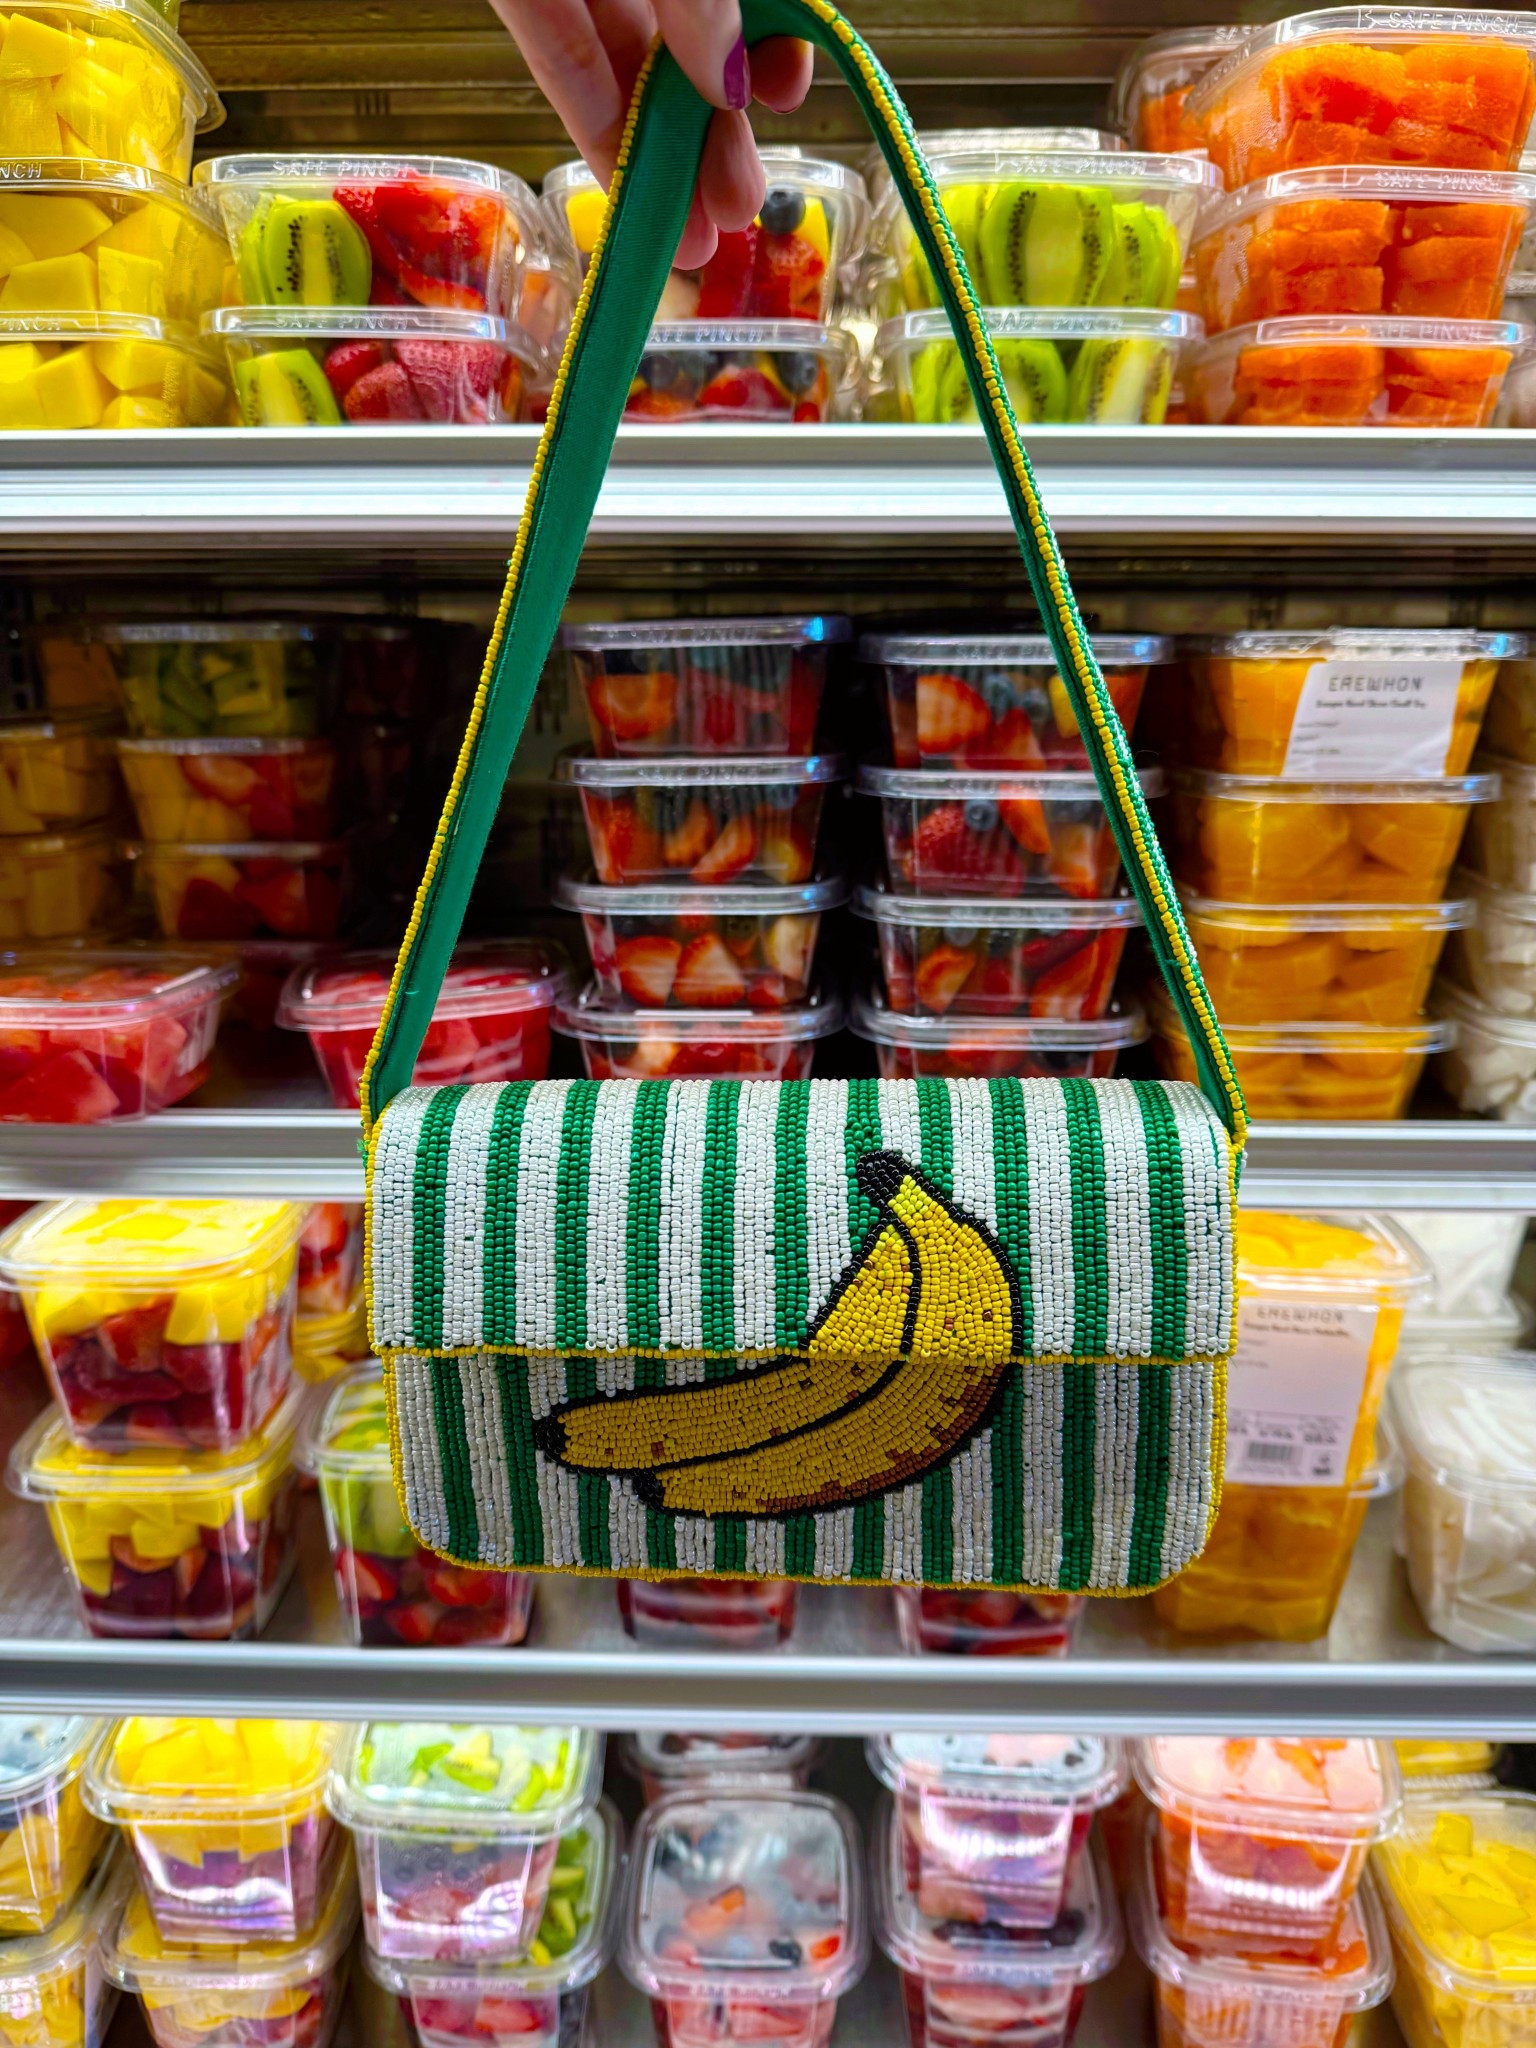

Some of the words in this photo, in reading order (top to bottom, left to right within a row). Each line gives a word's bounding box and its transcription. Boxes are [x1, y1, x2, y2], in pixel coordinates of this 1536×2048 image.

[1388, 11, 1444, 30] SAFE
[1451, 13, 1520, 34] PINCH
[272, 160, 328, 177] SAFE
[338, 161, 410, 179] PINCH
[650, 327, 684, 343] AFE
